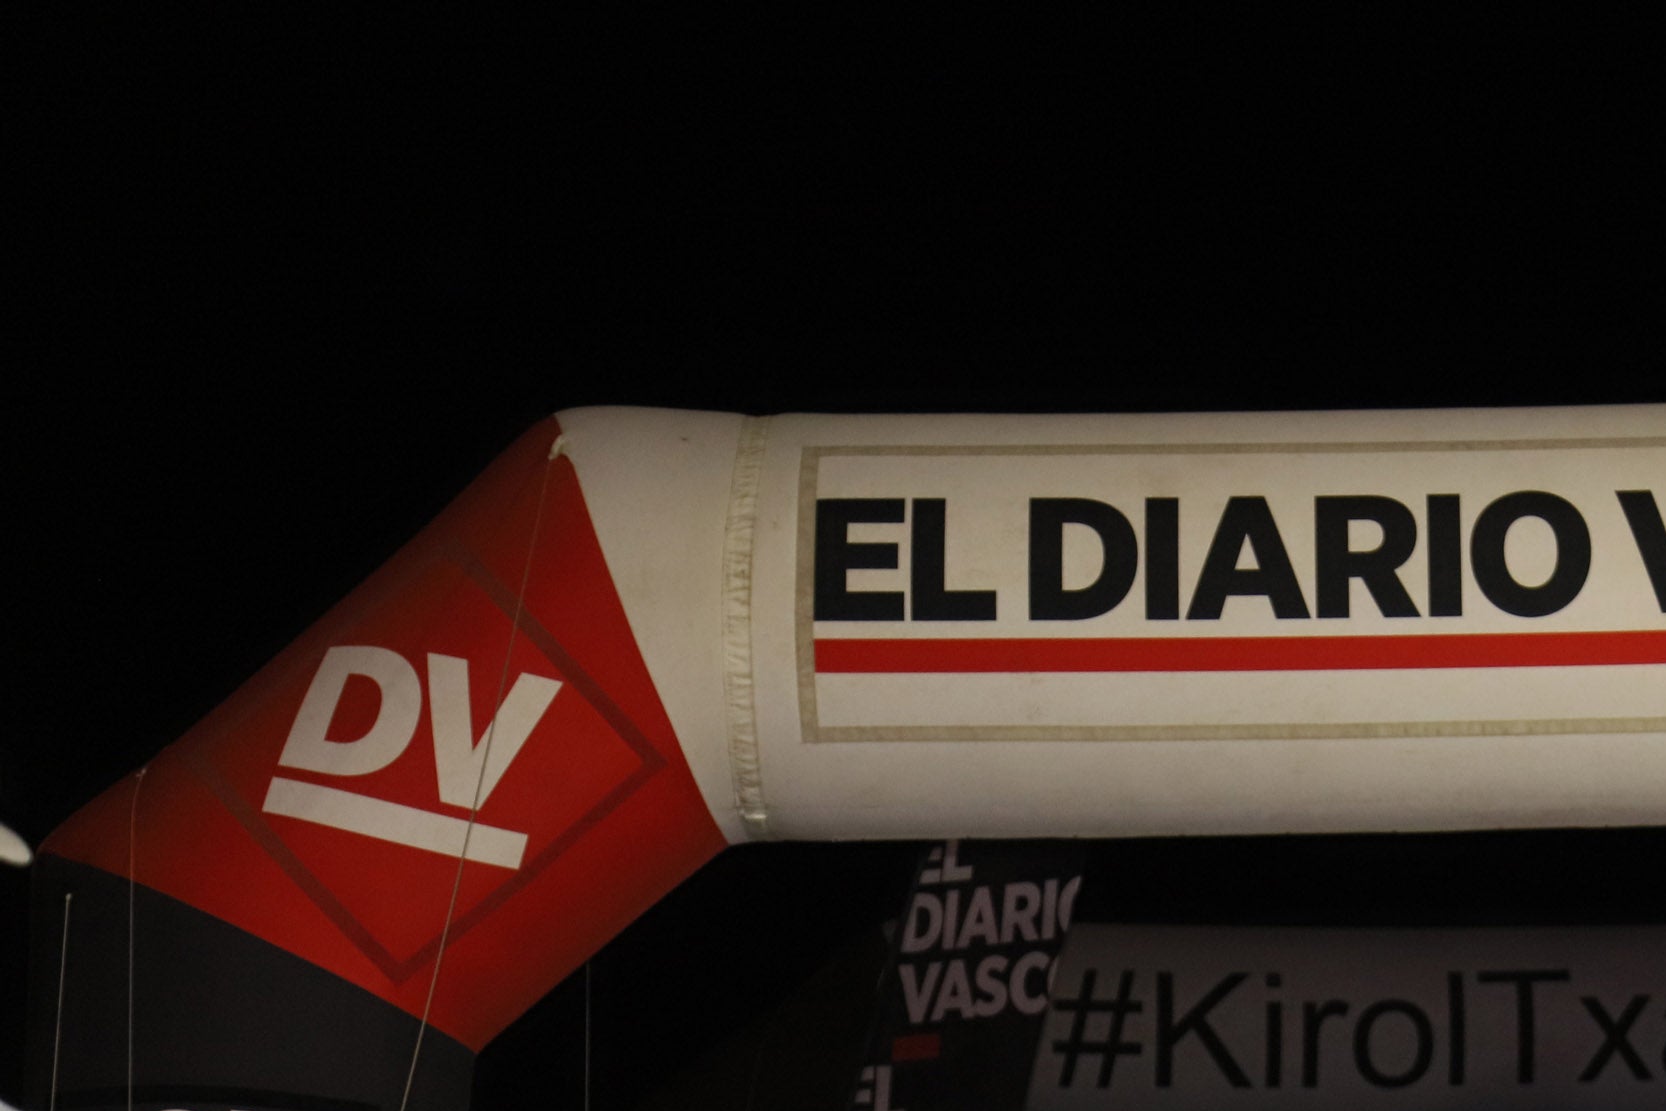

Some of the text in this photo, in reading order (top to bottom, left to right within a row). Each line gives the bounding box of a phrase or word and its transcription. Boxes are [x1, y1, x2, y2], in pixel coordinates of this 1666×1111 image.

[814, 496, 998, 622] EL
[1028, 490, 1592, 622] DIARIO
[278, 643, 564, 812] DV
[898, 951, 1058, 1024] VASC
